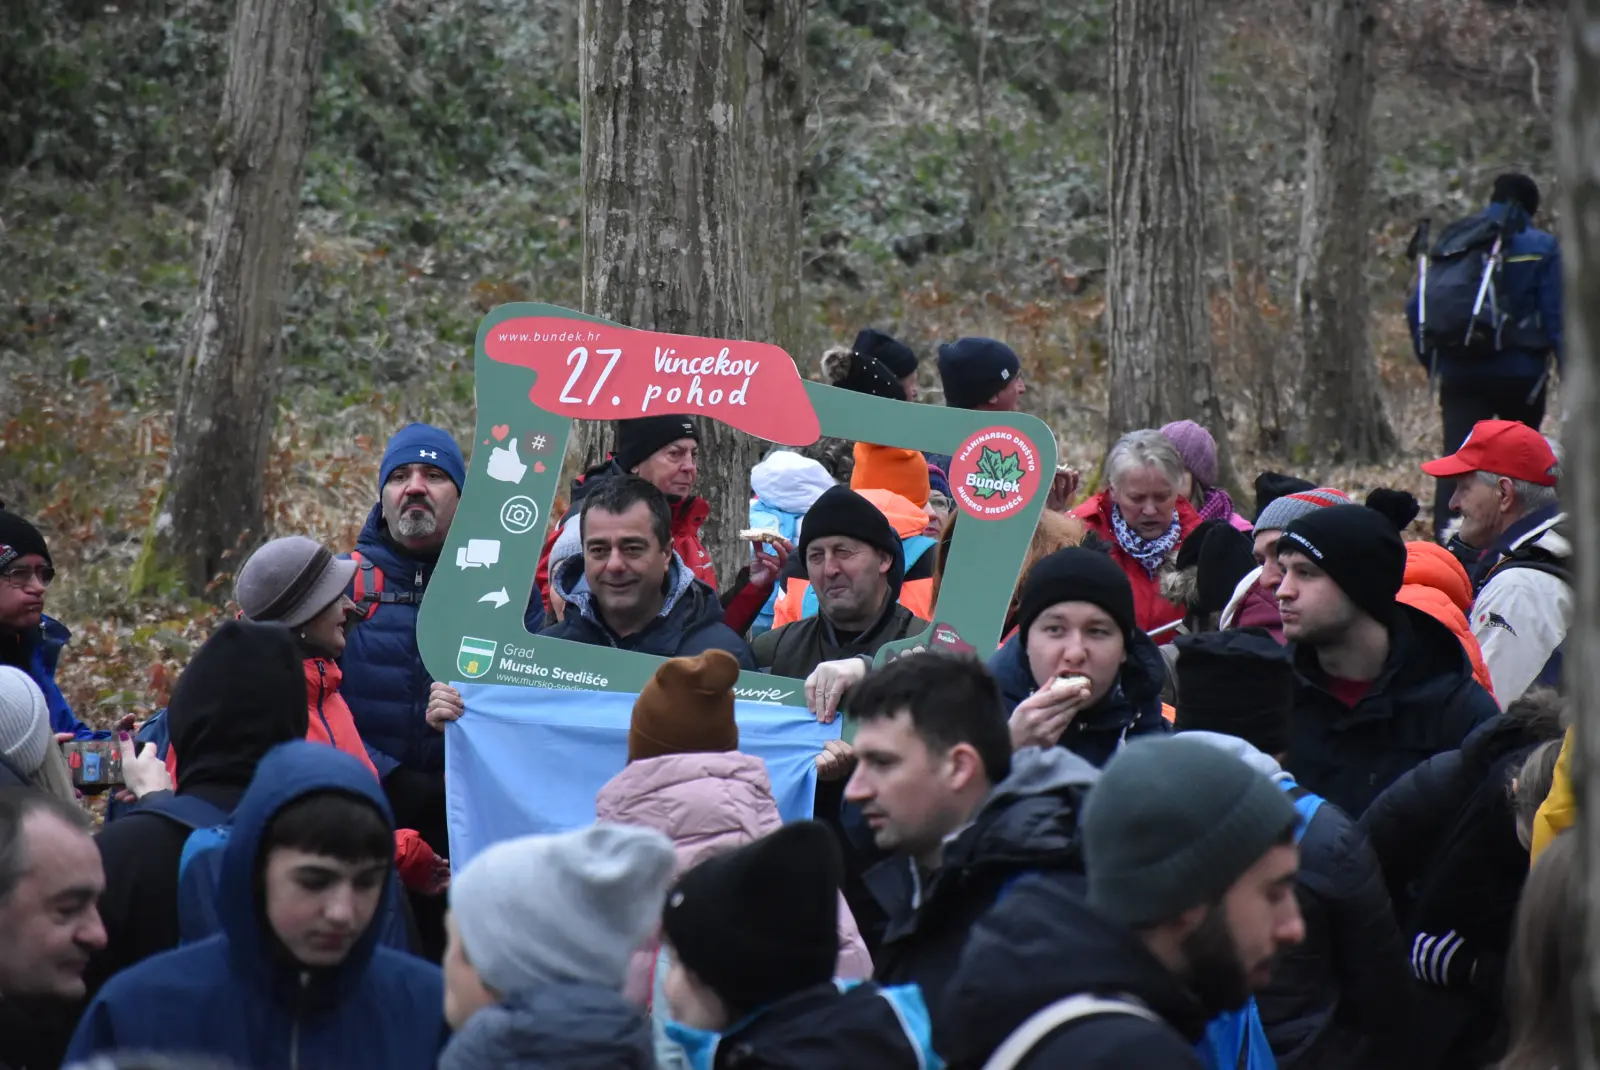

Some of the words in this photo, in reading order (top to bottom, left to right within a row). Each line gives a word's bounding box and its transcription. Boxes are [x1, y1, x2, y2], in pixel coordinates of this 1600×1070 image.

[499, 331, 601, 342] www.bundek.hr
[559, 346, 622, 406] 27.
[654, 346, 760, 376] Vincekov
[641, 375, 751, 412] pohod
[960, 432, 1013, 461] PLANINARSKO
[1013, 437, 1036, 472] DRUŠTVO
[965, 473, 1020, 493] Bundek
[957, 486, 983, 512] MURSKO
[503, 643, 535, 659] Grad
[499, 657, 549, 677] Mursko
[551, 667, 609, 687] Središće
